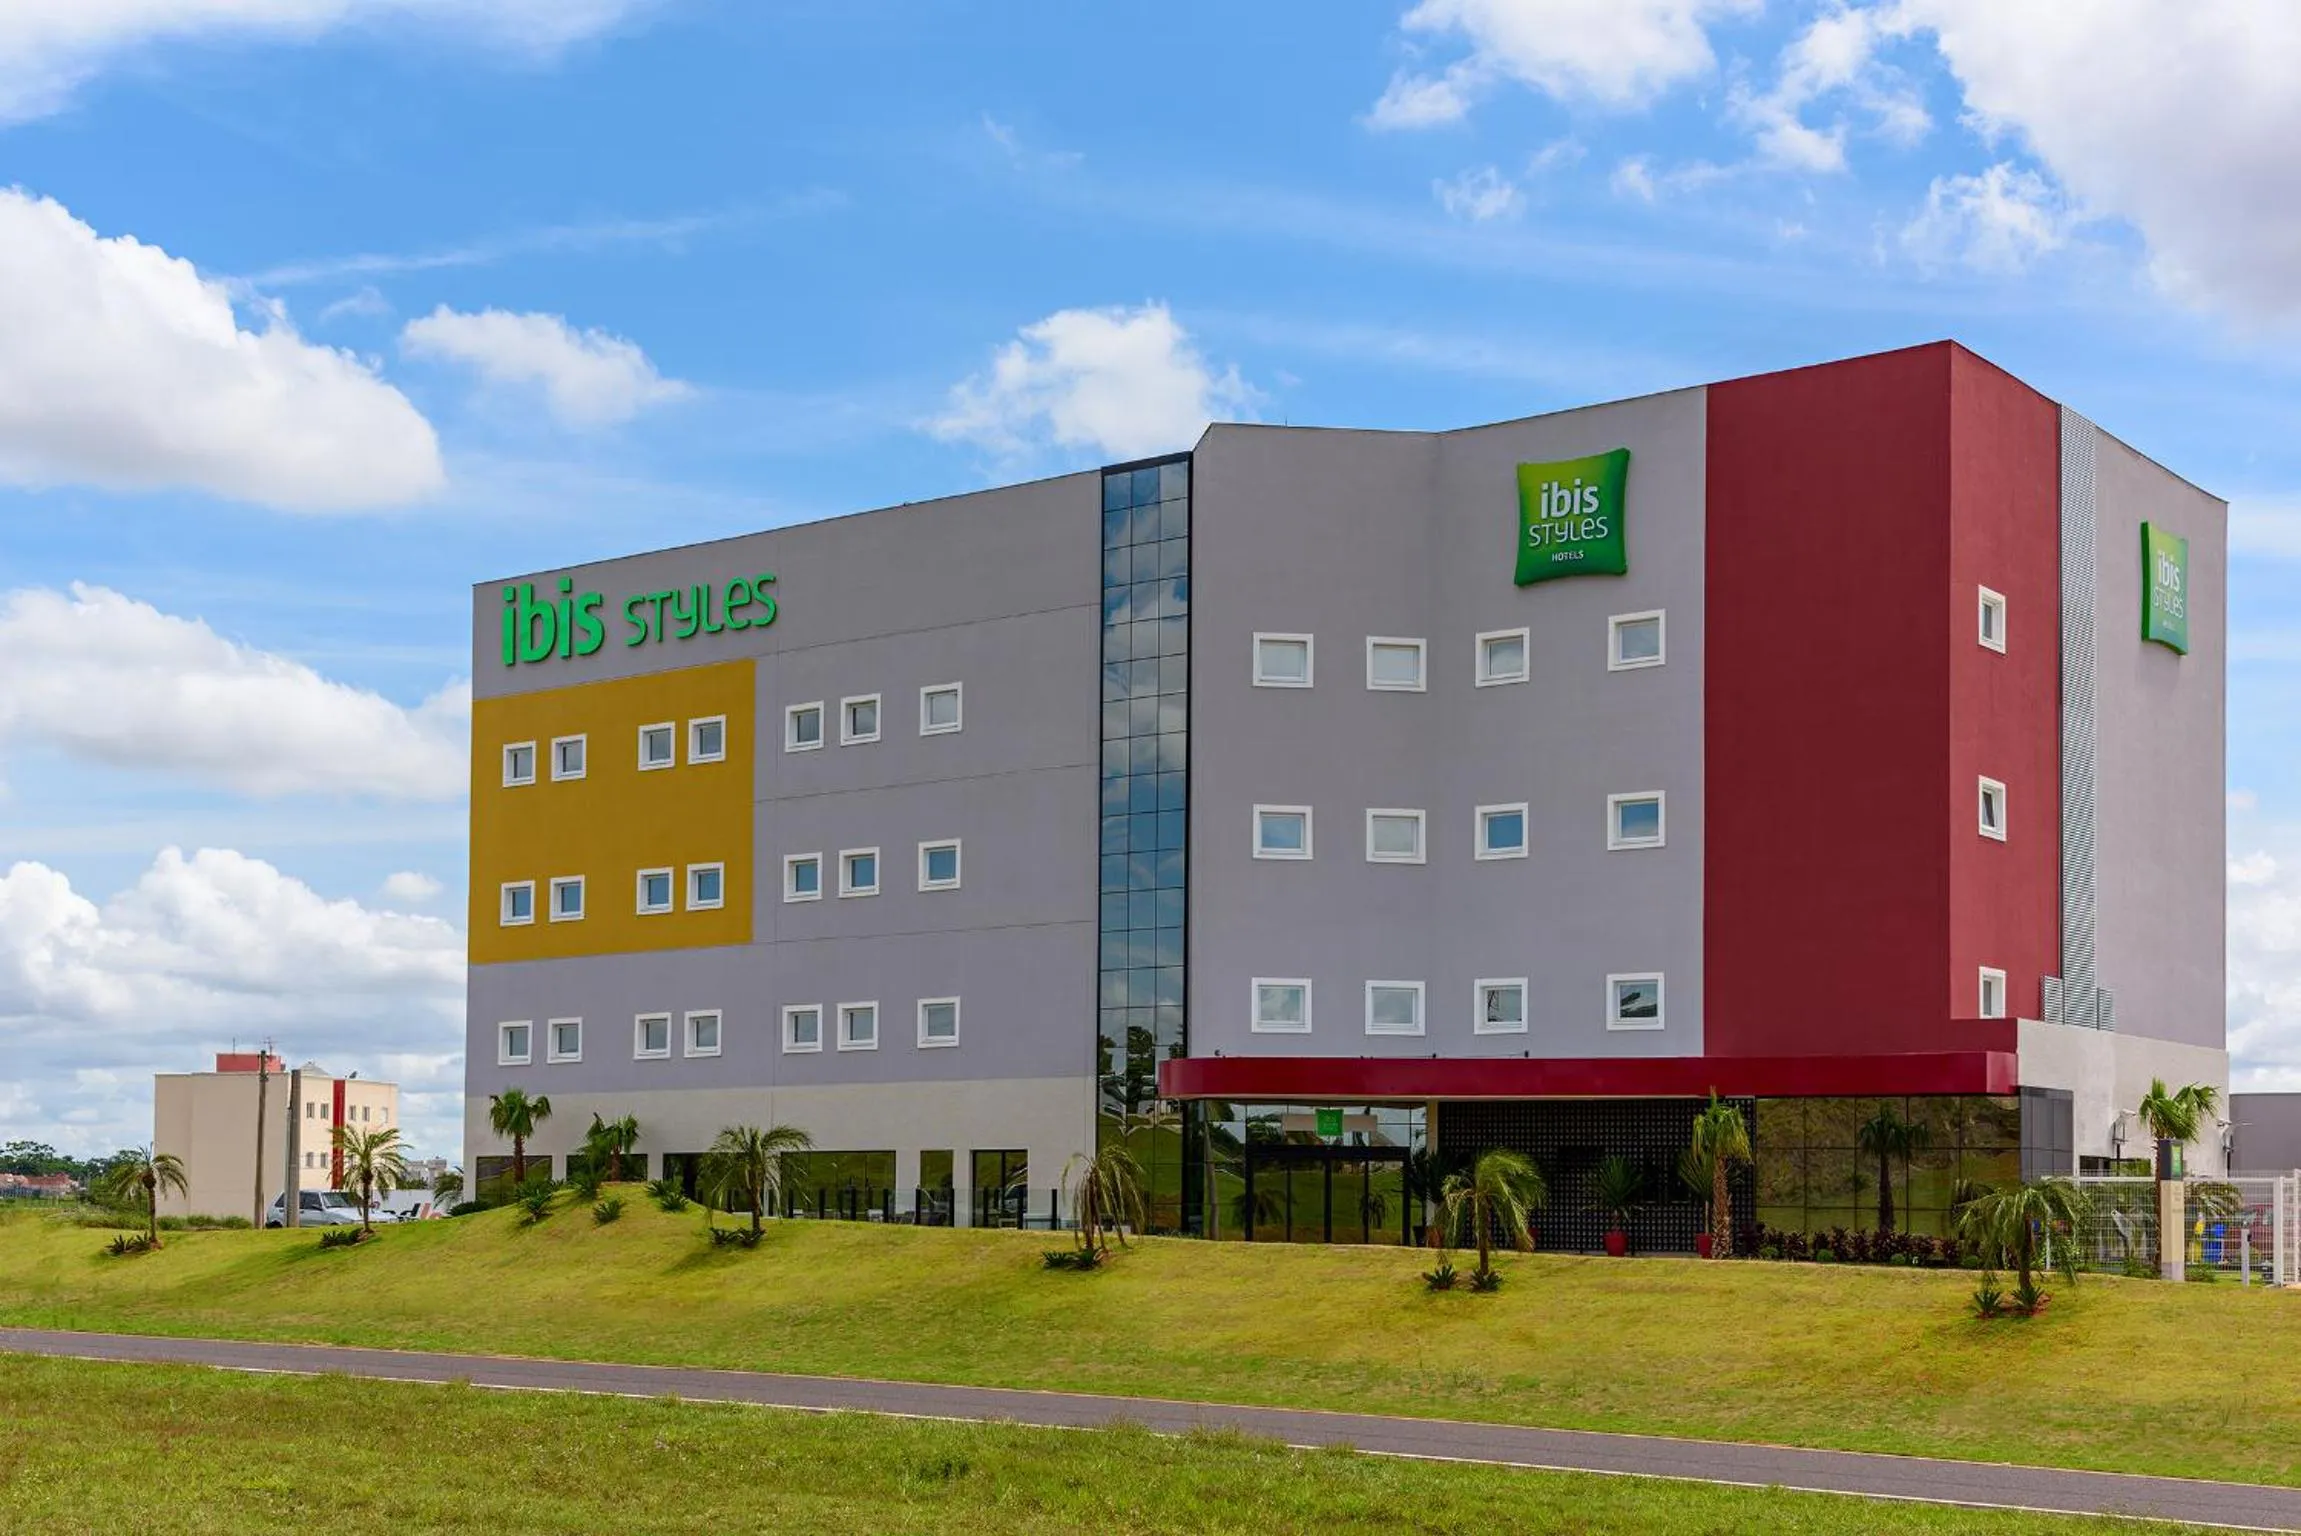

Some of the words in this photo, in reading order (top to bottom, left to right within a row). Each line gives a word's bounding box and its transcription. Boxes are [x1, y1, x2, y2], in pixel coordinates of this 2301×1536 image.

[1541, 478, 1600, 519] ibis
[1551, 550, 1585, 562] HOTELS
[2158, 550, 2181, 593] ibis
[502, 576, 605, 667] ibis
